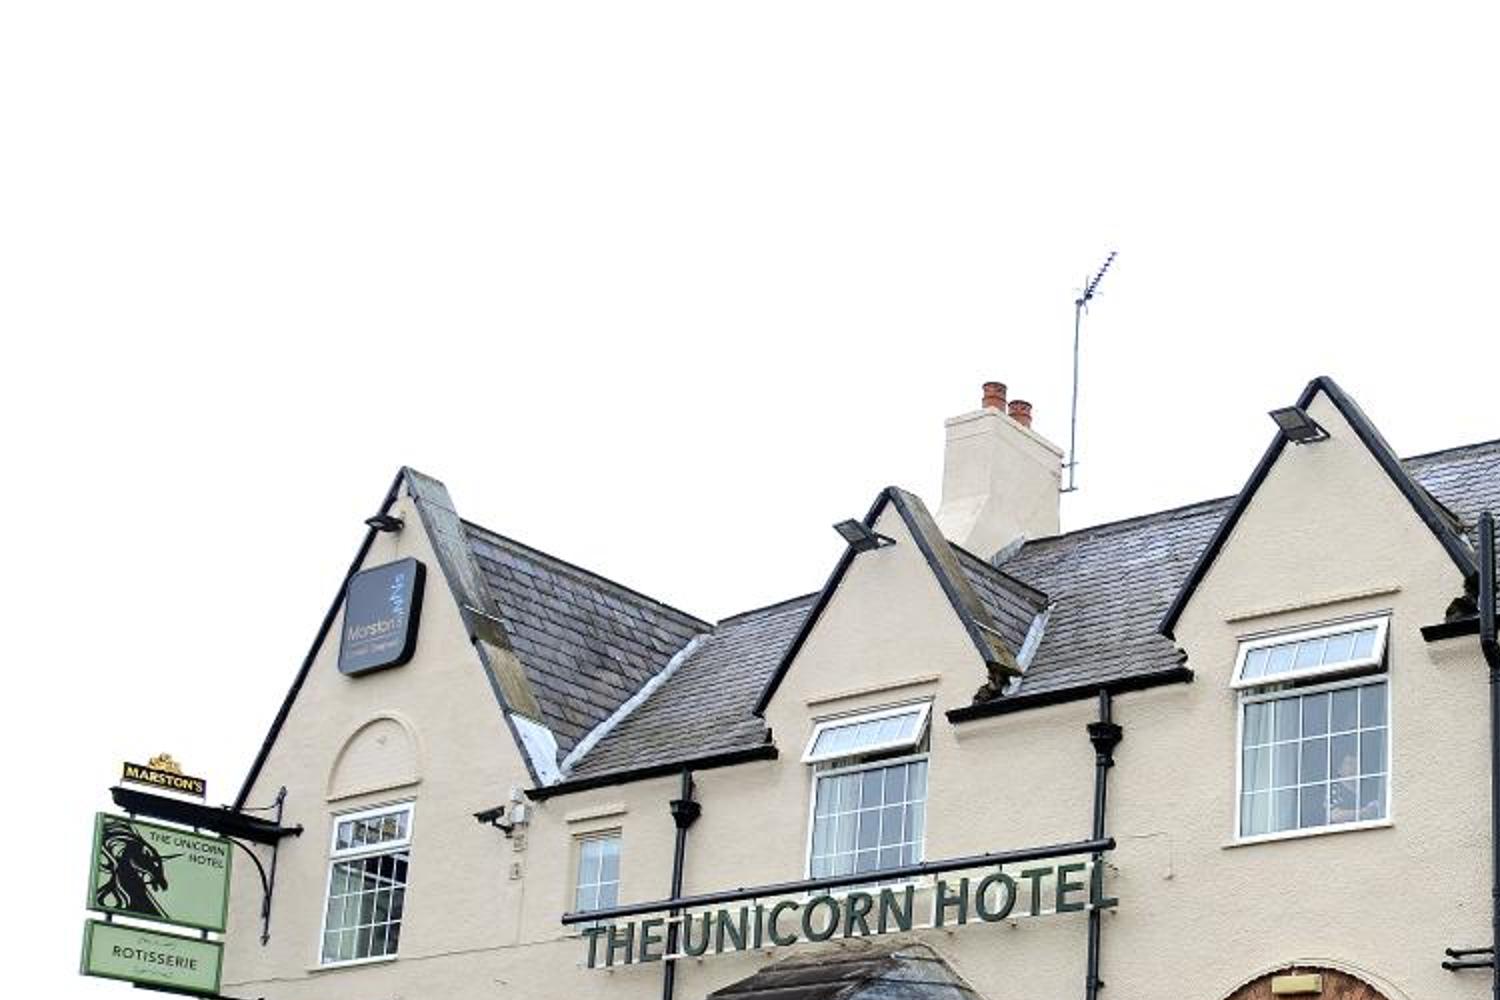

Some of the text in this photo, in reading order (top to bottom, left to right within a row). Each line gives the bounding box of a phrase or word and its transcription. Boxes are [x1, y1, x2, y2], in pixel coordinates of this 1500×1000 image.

[125, 766, 203, 793] MARSTON'S
[150, 831, 225, 857] THE UNICORN
[189, 854, 224, 869] HOTEL
[582, 856, 1120, 969] THE UNICORN HOTEL
[112, 945, 198, 971] ROTISSERIE
